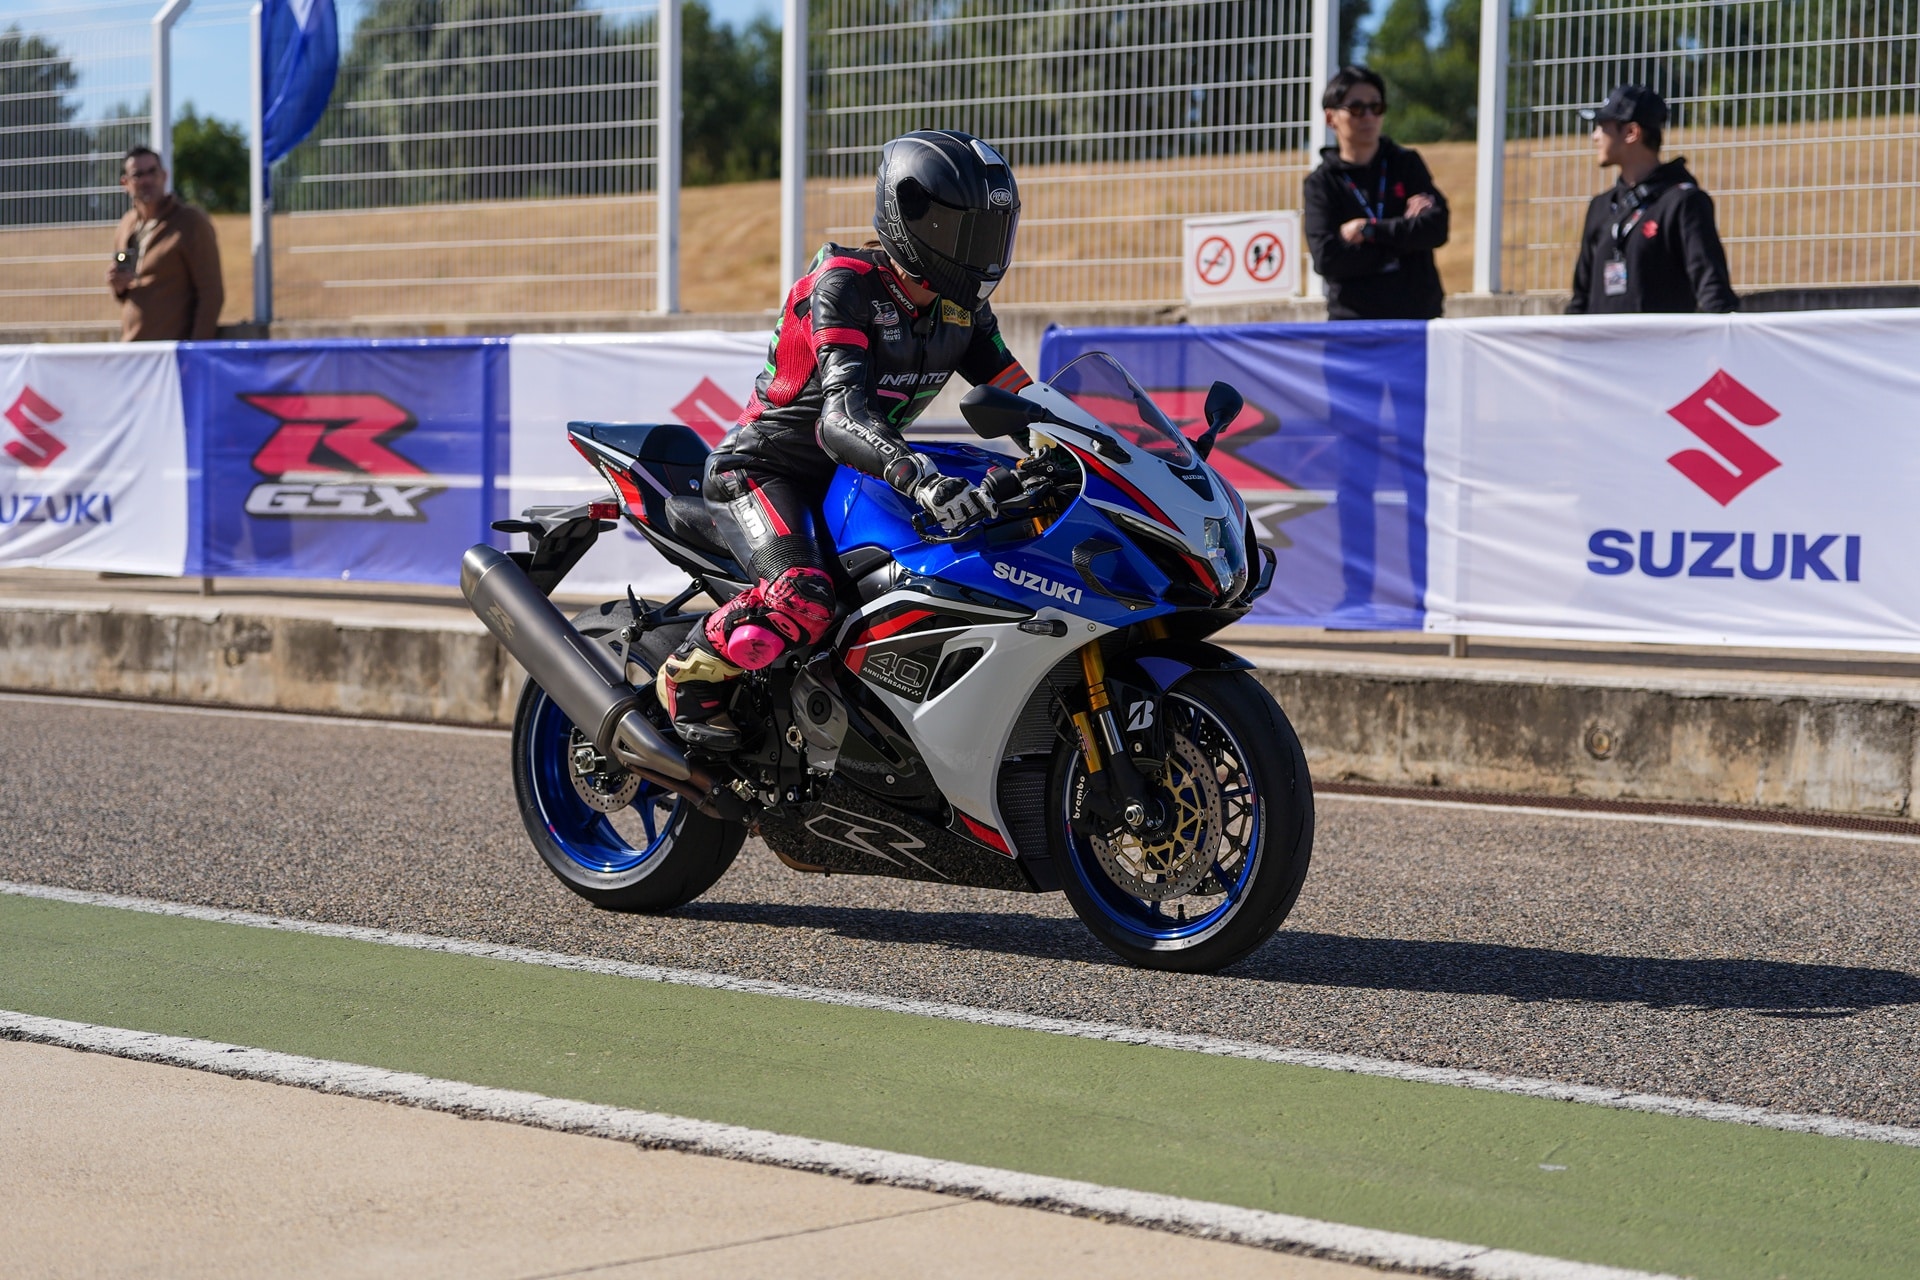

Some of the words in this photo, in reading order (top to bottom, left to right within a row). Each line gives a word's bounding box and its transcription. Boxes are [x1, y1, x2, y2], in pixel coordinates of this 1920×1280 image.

[889, 283, 915, 311] INFINITO
[878, 372, 949, 386] INFINITO
[837, 416, 896, 455] INFINITO
[0, 494, 113, 523] UZUKI
[245, 484, 429, 516] GSX
[1586, 529, 1861, 582] SUZUKI
[992, 561, 1083, 605] SUZUKI
[862, 666, 913, 693] ANNIVERSARY
[1072, 775, 1085, 819] brembo
